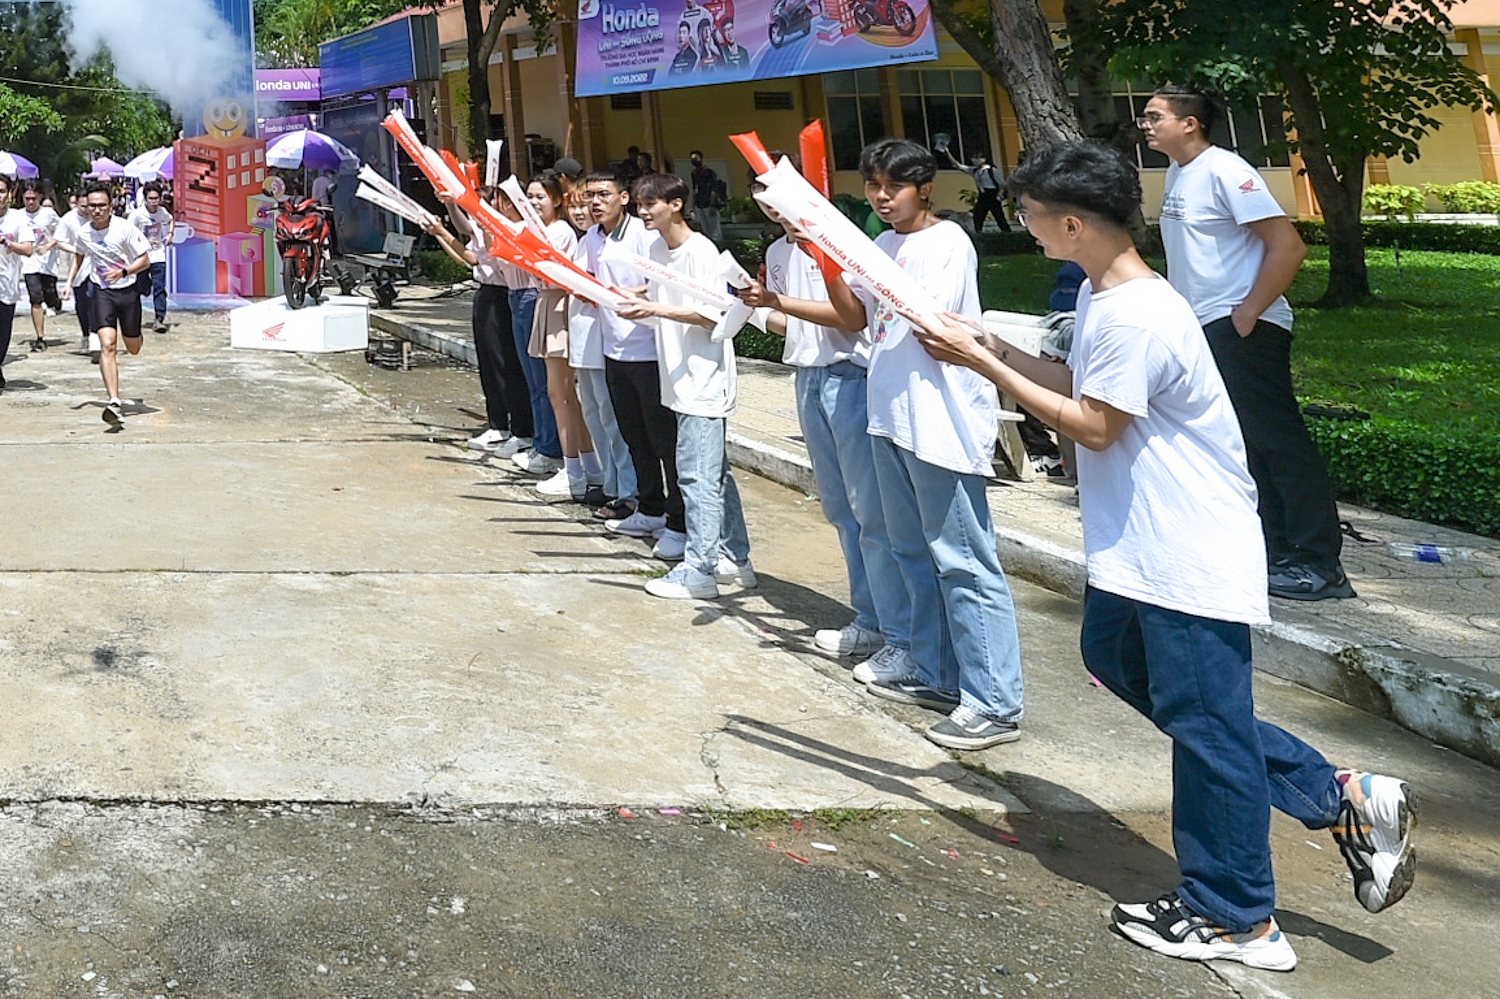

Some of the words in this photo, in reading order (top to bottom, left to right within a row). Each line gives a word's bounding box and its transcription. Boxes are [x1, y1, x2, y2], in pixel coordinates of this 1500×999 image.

[602, 3, 660, 34] Honda
[620, 32, 643, 48] SỐNG
[293, 81, 312, 90] UNI
[612, 72, 648, 85] 10.09.2022
[818, 232, 848, 261] Honda
[847, 258, 866, 276] UNI
[702, 288, 724, 302] Honda
